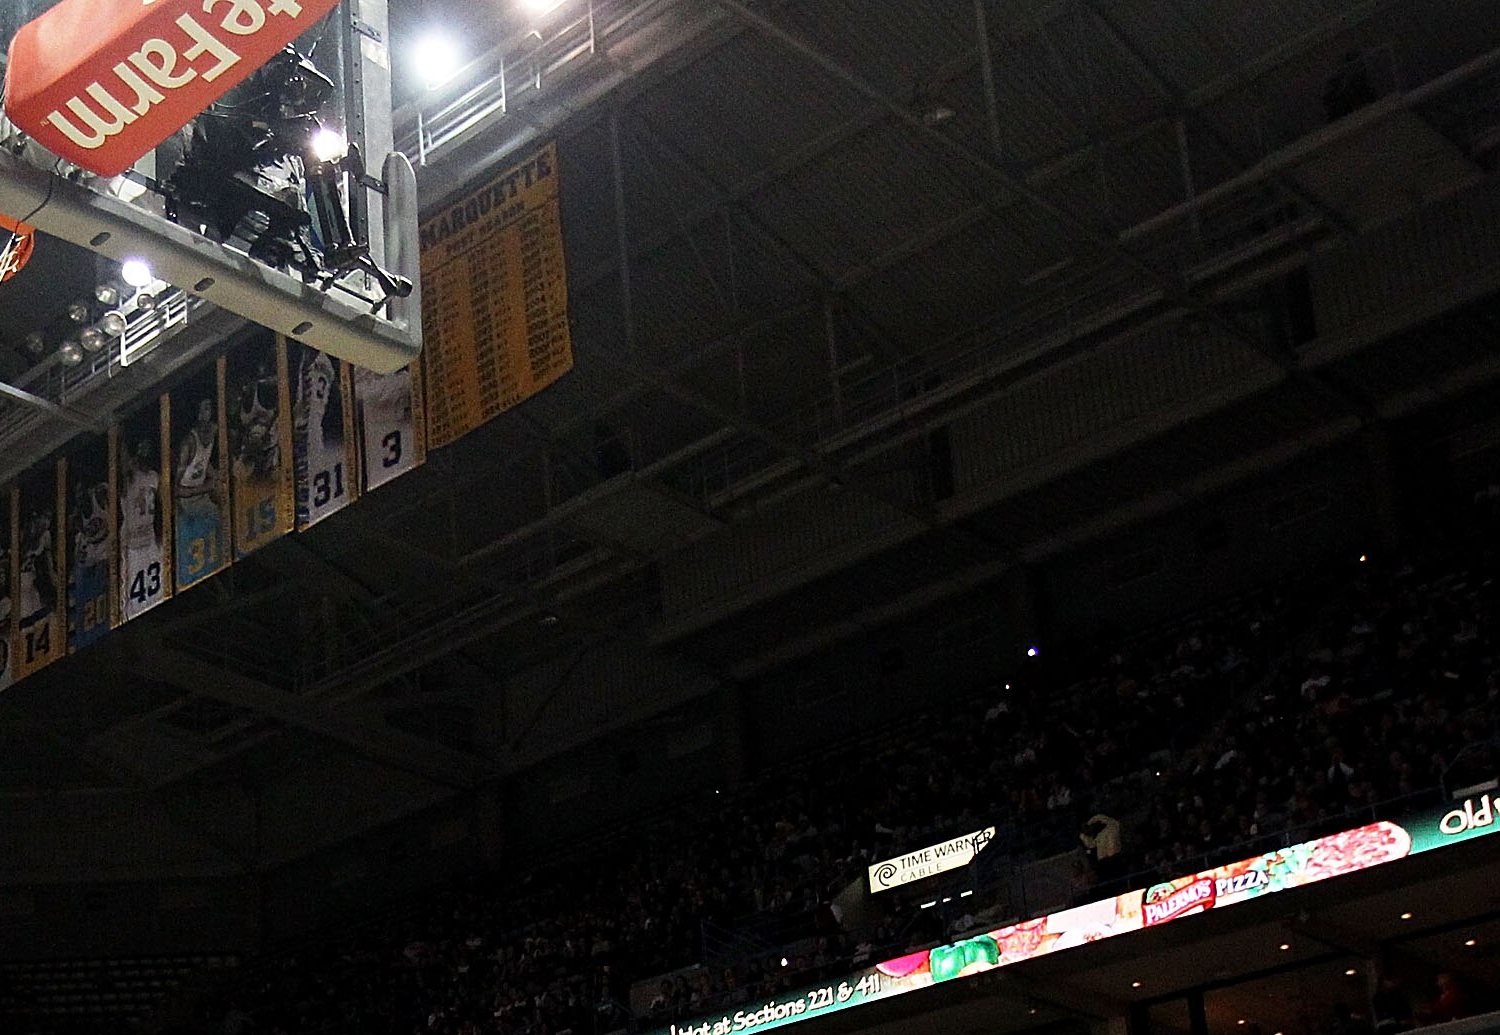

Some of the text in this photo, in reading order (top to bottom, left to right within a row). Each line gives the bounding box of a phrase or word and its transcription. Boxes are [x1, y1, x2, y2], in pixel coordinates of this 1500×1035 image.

[419, 155, 552, 249] MARQUETTE
[382, 429, 402, 468] 3
[312, 462, 344, 508] 31
[187, 530, 217, 575] 31
[130, 560, 162, 603] 43
[25, 622, 50, 664] 14
[1440, 794, 1494, 835] Old
[899, 831, 991, 869] TIME WARNER
[900, 863, 942, 882] CABLE
[1215, 870, 1269, 898] PIZZA
[713, 1016, 732, 1035] at
[732, 996, 805, 1032] Sections
[807, 985, 834, 1011] 221
[837, 983, 854, 1001] &
